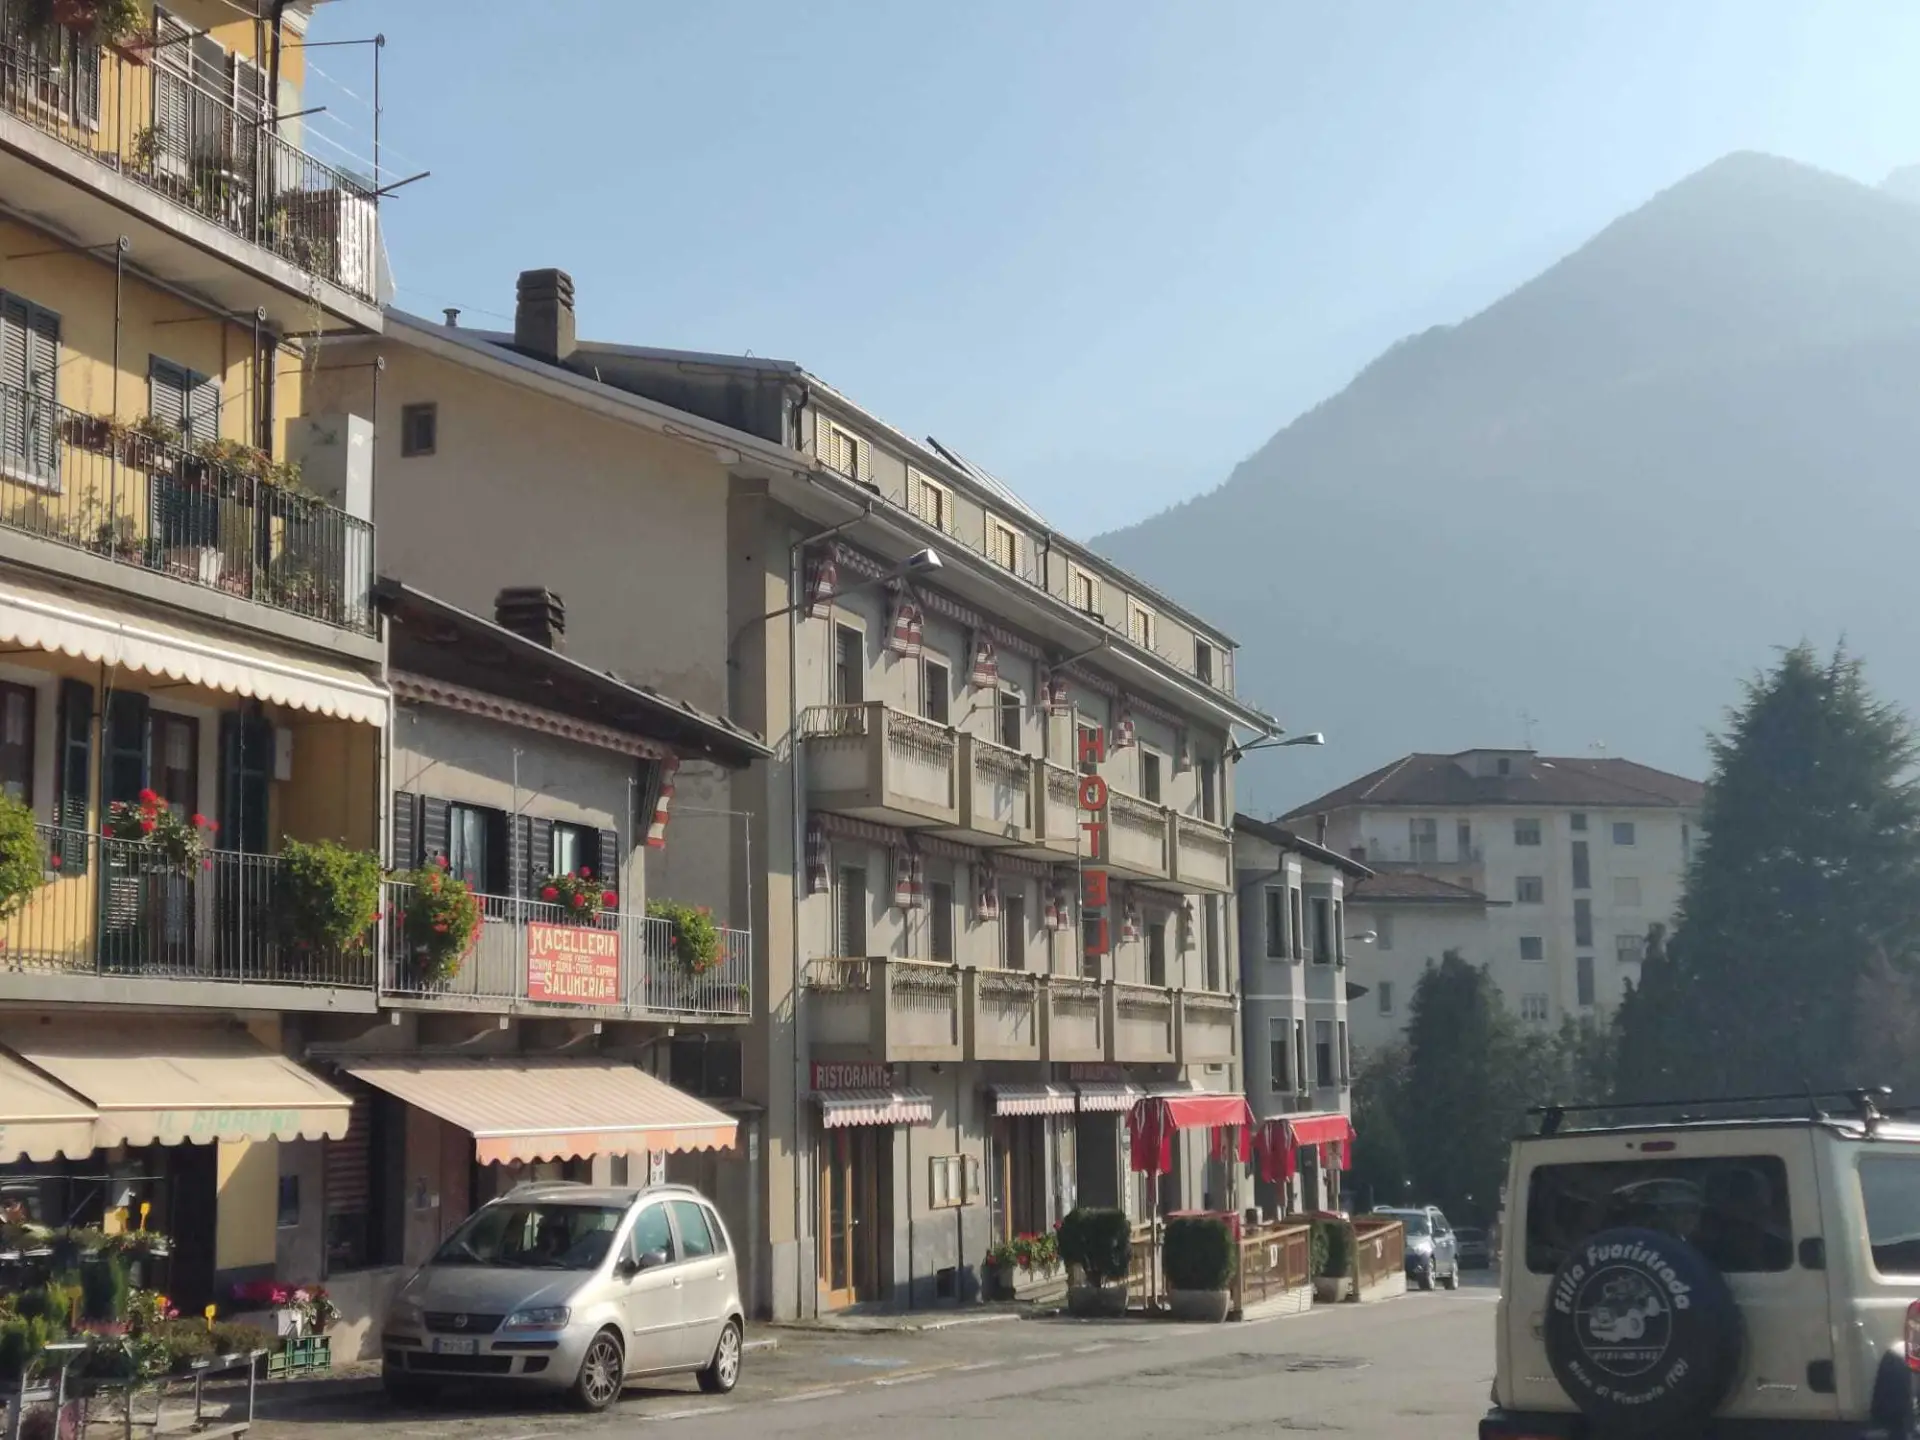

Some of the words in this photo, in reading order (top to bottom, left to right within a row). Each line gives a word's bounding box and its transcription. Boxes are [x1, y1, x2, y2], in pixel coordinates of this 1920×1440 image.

[529, 926, 616, 957] MACELLERIA
[543, 971, 605, 998] SALUMERIA
[816, 1064, 891, 1089] RISTORANTE
